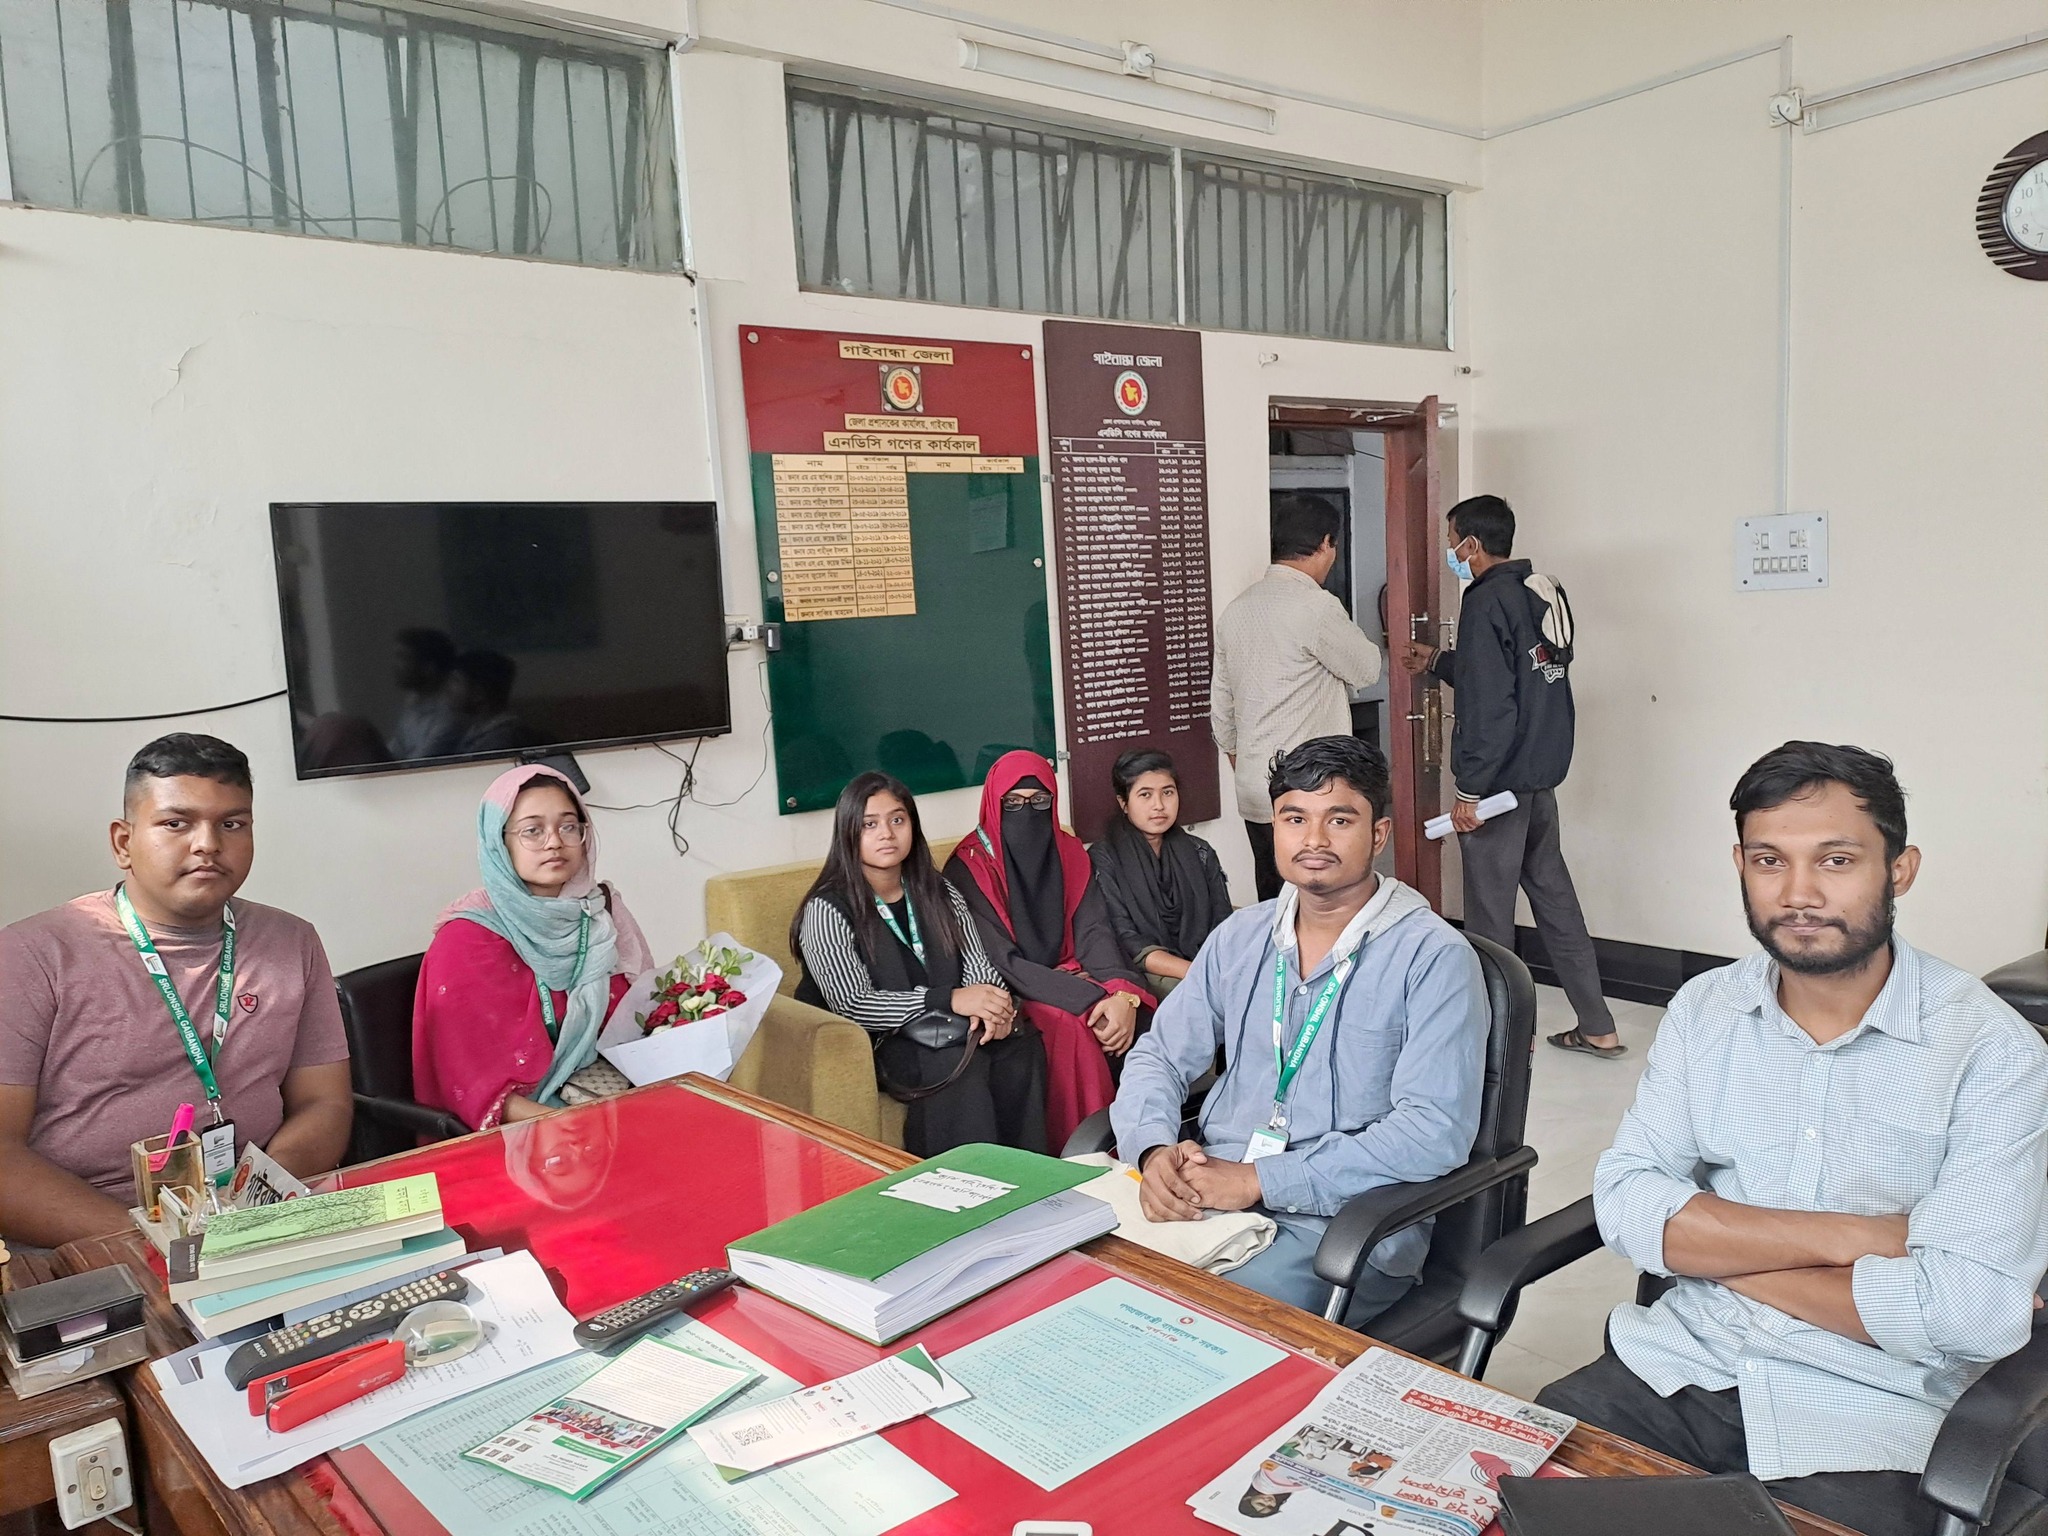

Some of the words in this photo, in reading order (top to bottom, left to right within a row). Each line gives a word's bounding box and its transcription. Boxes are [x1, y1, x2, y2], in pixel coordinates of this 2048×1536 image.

[2034, 172, 2045, 184] 11
[2021, 187, 2033, 199] 10
[2015, 206, 2022, 218] 9
[2022, 224, 2029, 235] 8
[2037, 233, 2044, 244] 7
[843, 344, 906, 359] গাইবান্ধা
[913, 349, 951, 362] জেলা
[1136, 355, 1163, 367] জেলা
[848, 416, 867, 428] জেলা
[828, 436, 881, 450] এনডিসি
[888, 438, 922, 450] গণের
[927, 438, 977, 452] কার্যকাল
[222, 931, 233, 972] GAIBANDHA
[219, 971, 232, 1014] SRIJONSHIL
[1274, 974, 1284, 1018] SRIJONSHIL
[540, 985, 553, 1025] GAIBANDHA
[1309, 981, 1336, 1024] SRIJONSHIL
[158, 977, 183, 1019] SRIJONSHIL
[180, 1020, 205, 1066] GAIBANDHA
[1288, 1024, 1315, 1068] GAIBANDHA
[1160, 1320, 1199, 1344] বাংলাদেশ
[1198, 1337, 1229, 1356] সরকার
[1373, 1441, 1393, 1452] প্রধান
[1398, 1475, 1467, 1500] ভূমিকম্প
[1393, 1488, 1439, 1507] অঞ্চল
[1443, 1501, 1489, 1530] রংপুর
